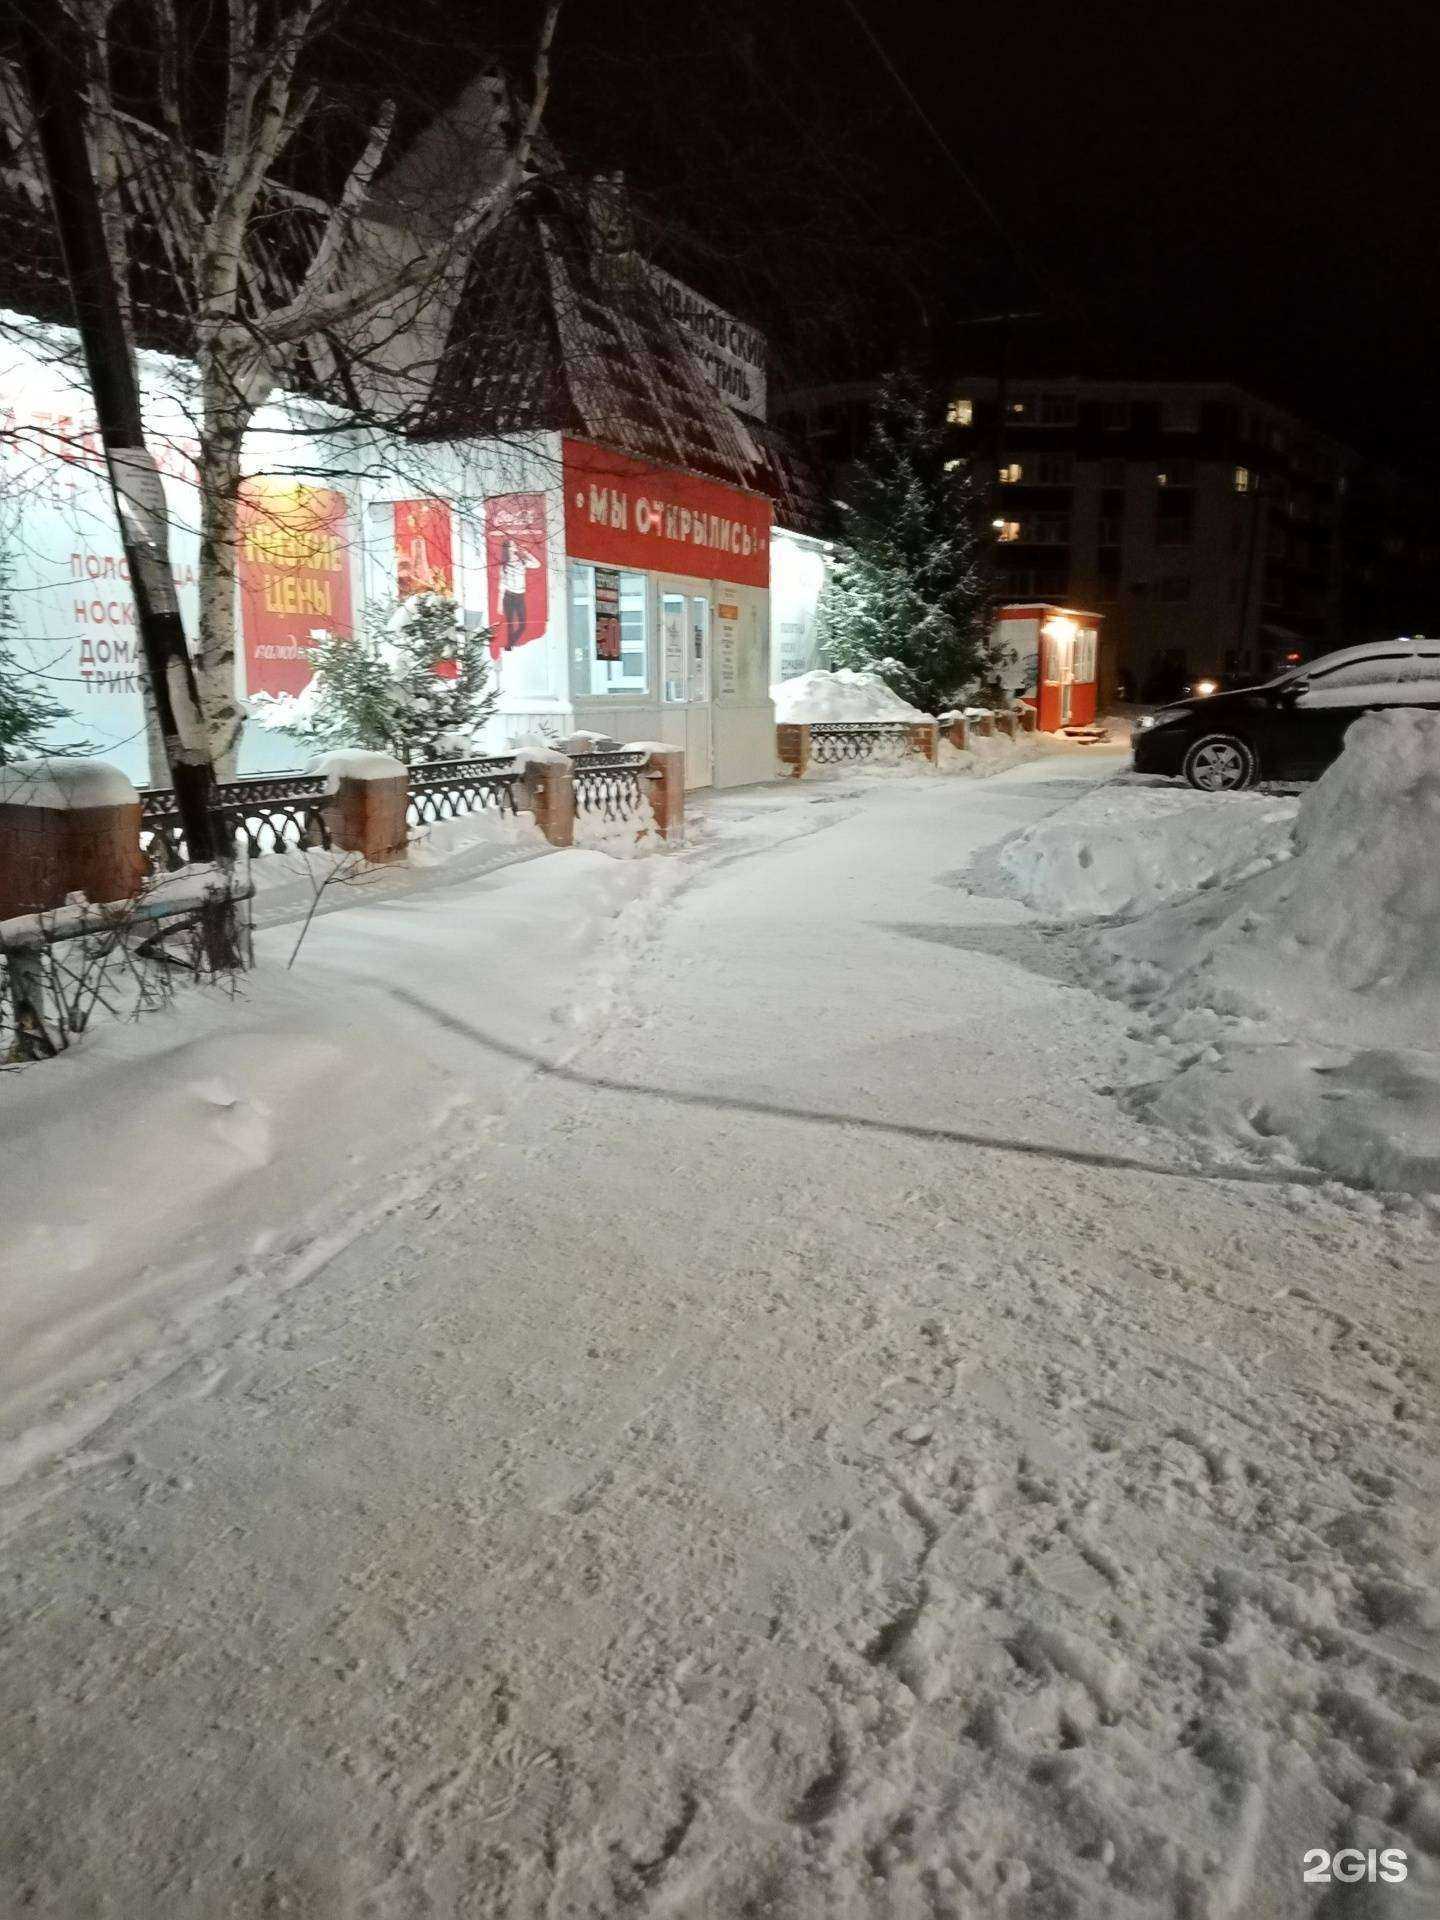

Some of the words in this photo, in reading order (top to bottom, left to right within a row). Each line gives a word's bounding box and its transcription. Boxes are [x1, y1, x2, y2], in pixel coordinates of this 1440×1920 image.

[589, 483, 628, 530] МЫ
[73, 599, 136, 625] НОСК
[264, 574, 332, 618] ЦЕНЫ
